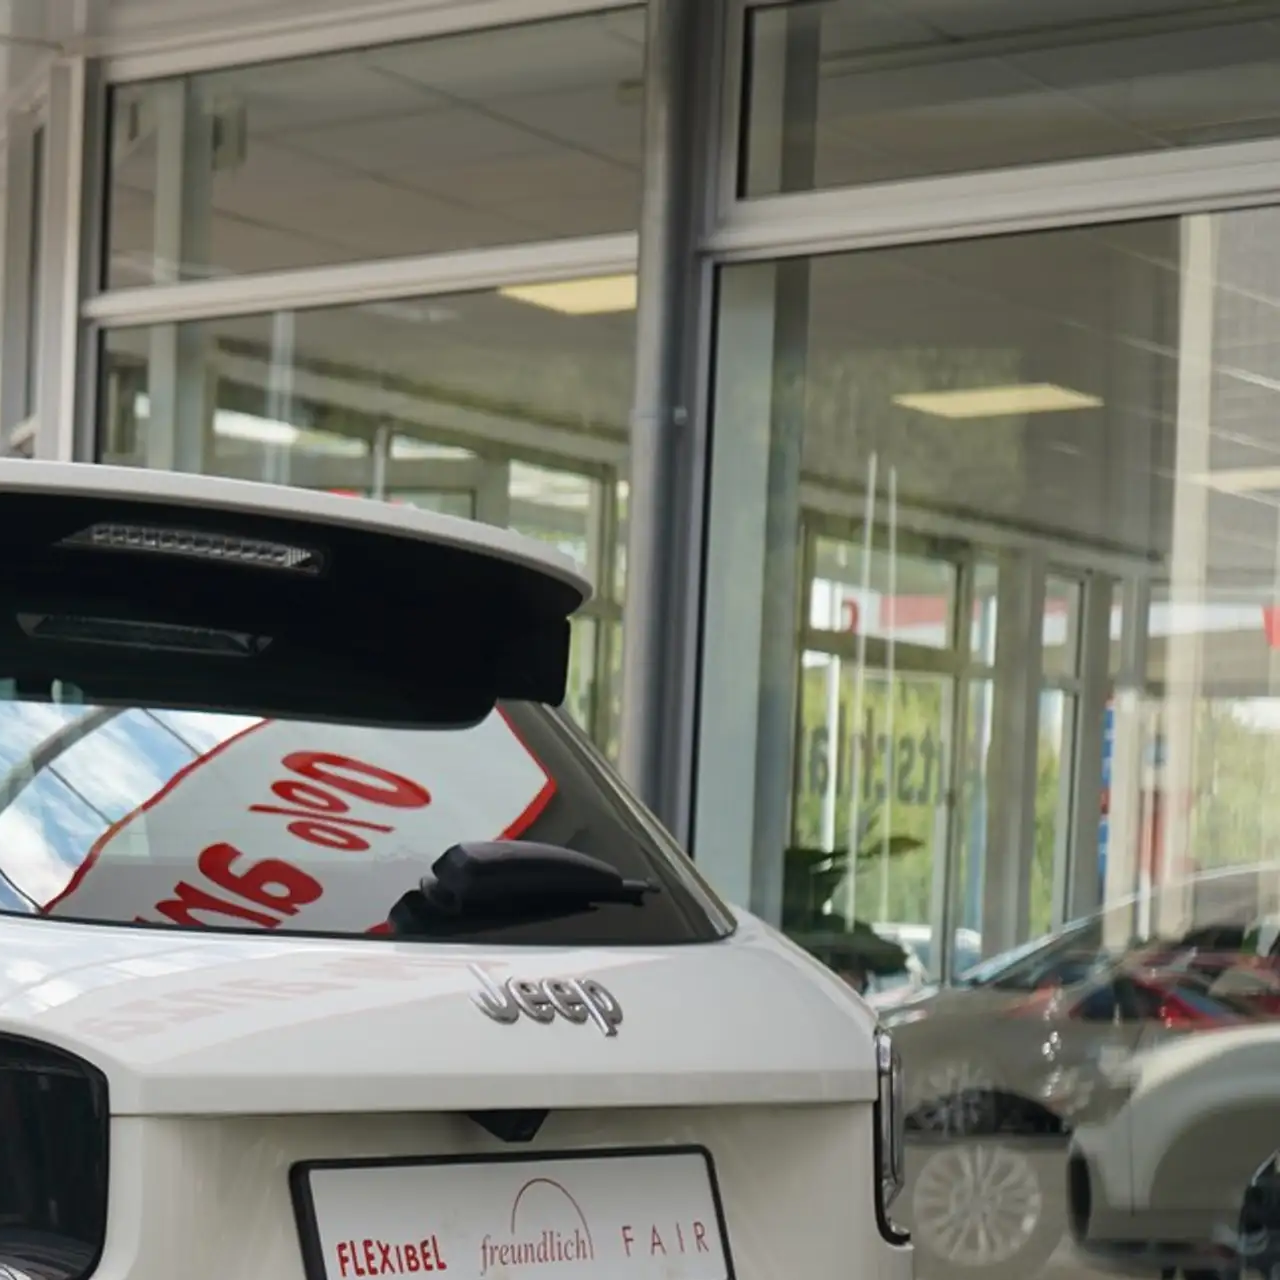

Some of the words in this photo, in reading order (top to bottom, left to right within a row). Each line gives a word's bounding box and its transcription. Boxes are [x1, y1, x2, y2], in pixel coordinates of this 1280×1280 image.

[467, 963, 623, 1037] Jeep
[336, 1235, 448, 1278] FLEXIBEL
[479, 1229, 589, 1276] freundlich
[621, 1221, 710, 1258] FAIR
